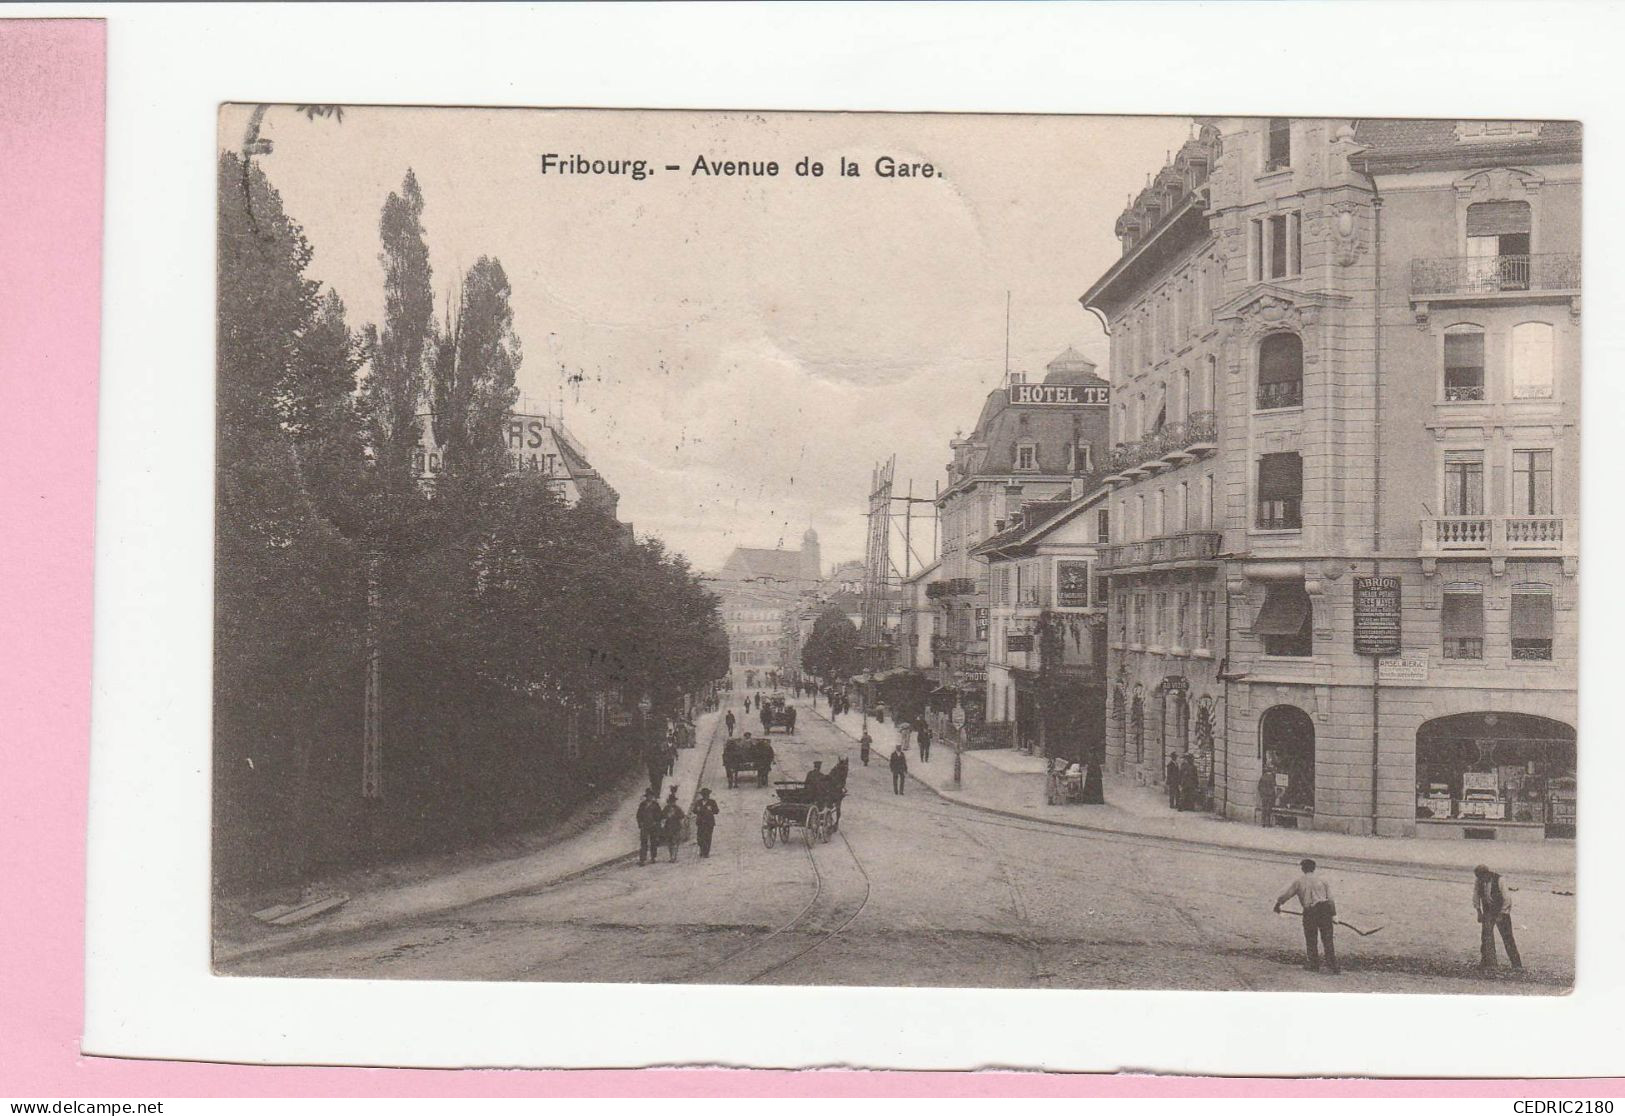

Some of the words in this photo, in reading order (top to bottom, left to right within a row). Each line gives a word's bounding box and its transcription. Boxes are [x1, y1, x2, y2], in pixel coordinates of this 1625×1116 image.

[542, 154, 654, 180] Fribourg.
[691, 155, 779, 176] Avenue
[795, 157, 824, 177] de
[840, 156, 860, 177] la
[875, 157, 943, 177] Gare.
[1084, 387, 1109, 403] TE
[508, 420, 543, 449] RS
